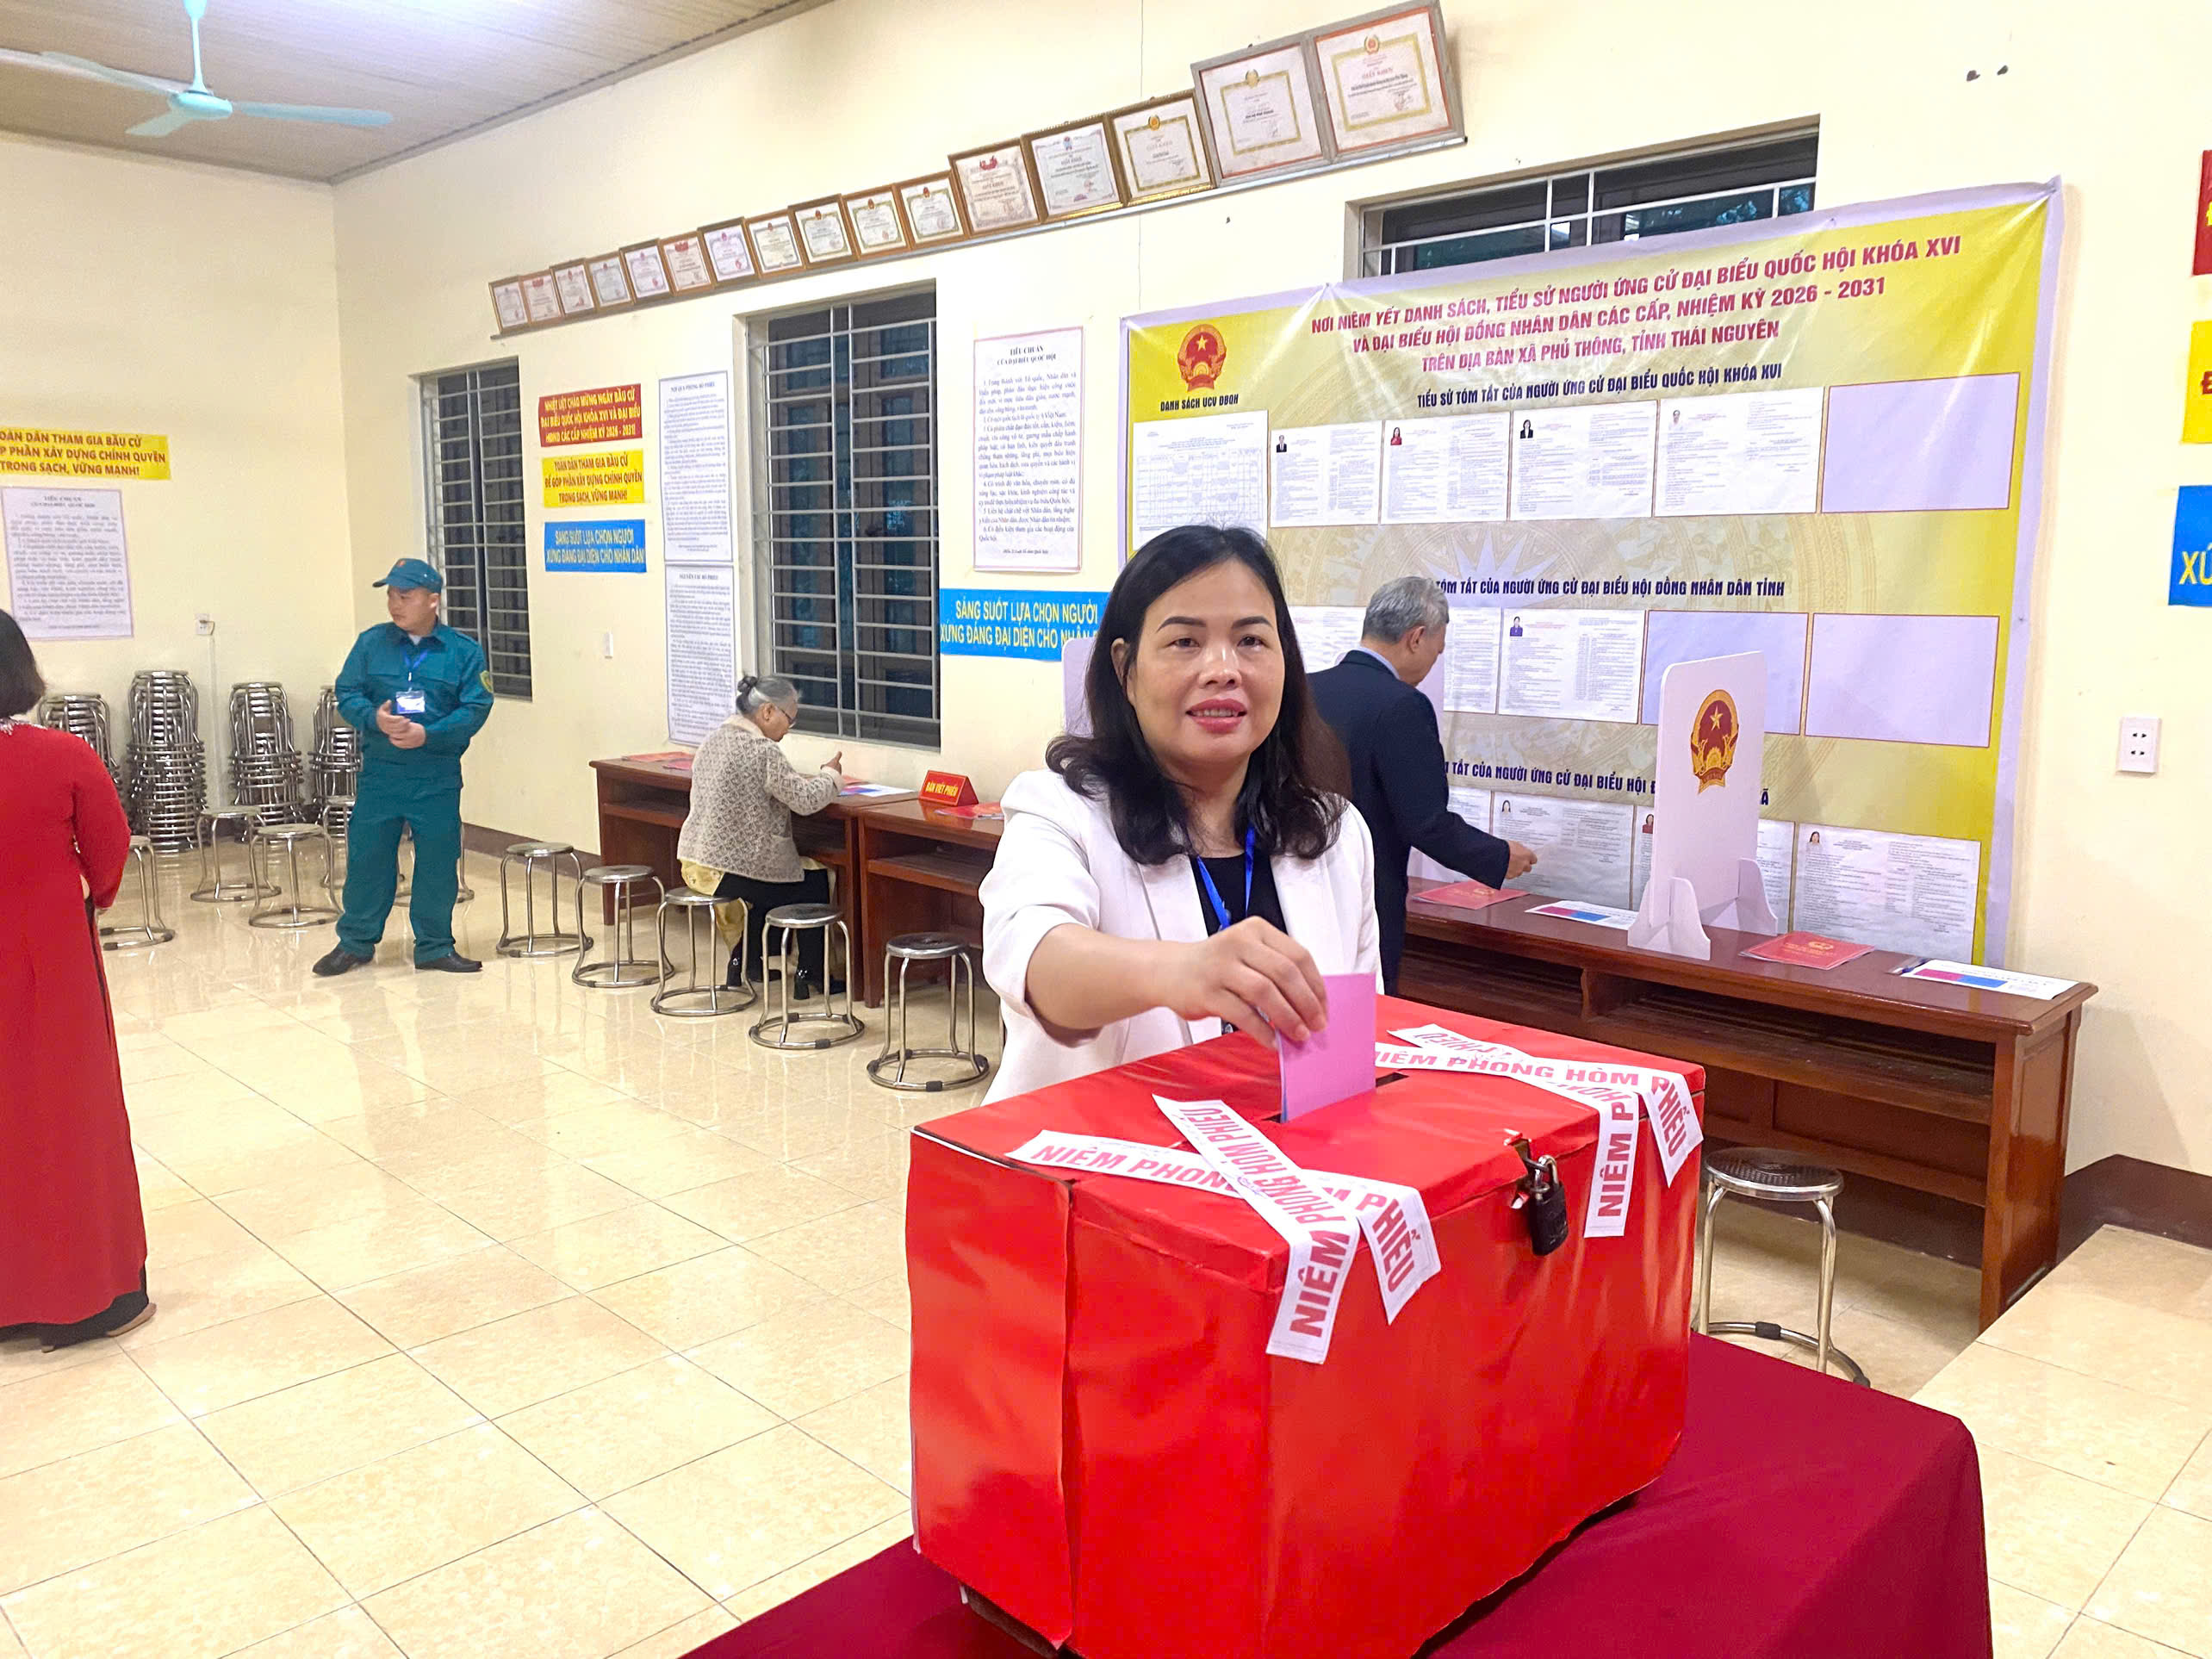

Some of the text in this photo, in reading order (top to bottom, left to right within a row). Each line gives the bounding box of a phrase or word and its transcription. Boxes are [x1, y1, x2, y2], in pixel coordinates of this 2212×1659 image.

[1312, 235, 1960, 333] NƠI NIÊM YẾT DANH SÁCH, TIỂU SỬ NGƯỜI ỨNG CỬ ĐẠI BIỂU QUỐC HỘI KHÓA XVI
[1353, 337, 1370, 353] VÀ
[1372, 334, 1394, 355] ĐẠI
[1399, 326, 1431, 348] BIỂU
[1436, 327, 1460, 346] HỘI
[1510, 314, 1554, 336] NHÂN
[1559, 309, 1592, 331] DÂN
[1598, 305, 1630, 326] CÁC
[1637, 298, 1671, 321] CẤP,
[1676, 293, 1735, 317] NHIỆM
[1771, 284, 1817, 307] 2026
[1838, 276, 1885, 299] 2031
[1422, 354, 1455, 372] TRÊN
[1486, 347, 1514, 366] BÀN
[1519, 344, 1536, 363] XÃ
[1541, 337, 1569, 361] PHỦ
[1575, 333, 1626, 357] THÔNG,
[1632, 329, 1666, 352] TỈNH
[1671, 326, 1706, 346] THÁI
[1712, 318, 1780, 342] NGUYÊN
[1418, 363, 1782, 408] TIỂU SỬ TÓM TẮT CỦA NGƯỜI ỨNG CỬ ĐẠI BIỂU QUỐC HỘI KHÓA XVI
[0, 431, 22, 442] OÀN
[1460, 576, 1477, 594] TẮT
[1480, 577, 1500, 594] CỦA
[1502, 579, 1534, 594] NGƯỜI
[1538, 578, 1559, 594] ỨNG
[1563, 576, 1578, 594] CỬ
[1581, 581, 1600, 597] ĐẠI
[1603, 575, 1628, 595] BIỂU
[1631, 579, 1651, 598] HỘI
[1655, 575, 1687, 595] ĐỒNG
[1690, 579, 1723, 595] NHÂN
[1727, 579, 1752, 596] DÂN
[1756, 577, 1785, 596] TỈNH
[956, 596, 1098, 627] SÁNG SUỐT LỰA CHỌN NGƯỜI
[941, 620, 964, 643] XỨNG
[966, 622, 992, 644] ĐÁNG
[995, 626, 1011, 651] ĐẠI
[1013, 625, 1035, 652] DIỆN
[1037, 628, 1058, 649] CHO
[1452, 758, 1469, 776] TẮT
[1471, 761, 1492, 778] CỦA
[1495, 765, 1527, 781] NGƯỜI
[1531, 767, 1552, 784] ỨNG
[1556, 768, 1571, 786] CỬ
[1574, 774, 1593, 791] ĐẠI
[1597, 772, 1623, 791] BIỂU
[1626, 776, 1646, 796] HỘI
[1447, 1057, 1554, 1078] PHONG
[1566, 1067, 1638, 1085] HÒM
[1030, 1145, 1128, 1169] NIÊM
[1128, 1159, 1238, 1191] PHON
[1598, 1134, 1632, 1216] NIÊM
[1253, 1176, 1346, 1224] PHONG
[1289, 1229, 1350, 1338] NIÊM
